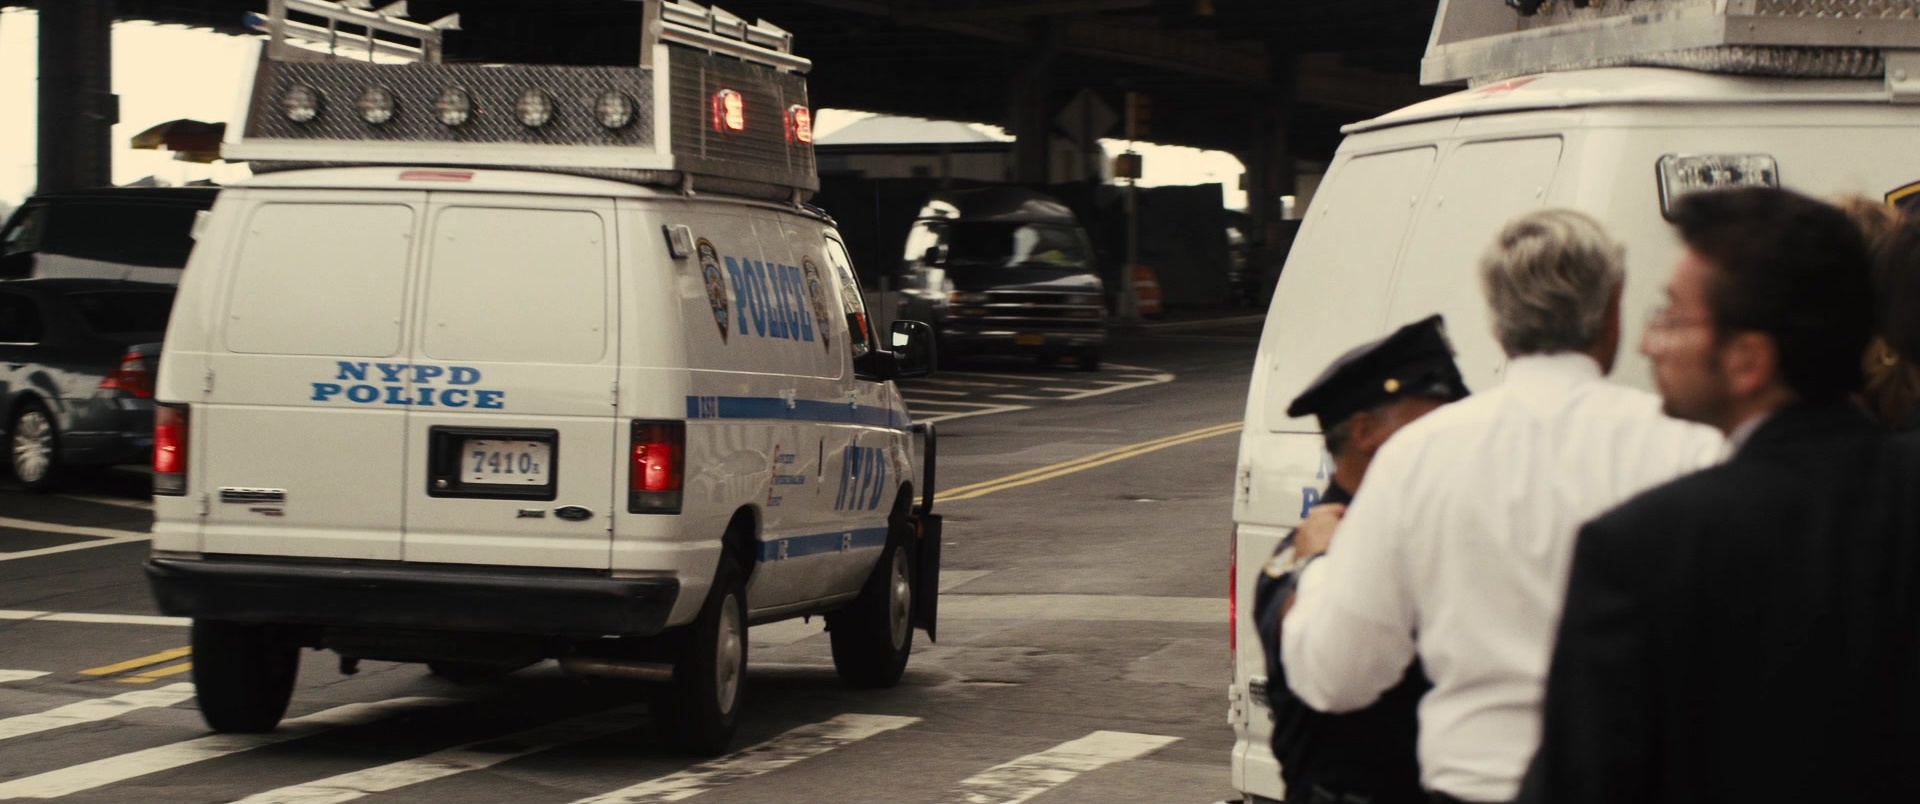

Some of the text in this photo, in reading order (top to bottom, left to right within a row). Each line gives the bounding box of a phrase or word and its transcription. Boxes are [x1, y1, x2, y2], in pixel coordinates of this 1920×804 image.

[724, 256, 814, 342] POLICE
[336, 361, 481, 385] NYPD
[310, 383, 505, 409] POLICE
[472, 451, 532, 474] 7410
[834, 446, 886, 510] NYPD
